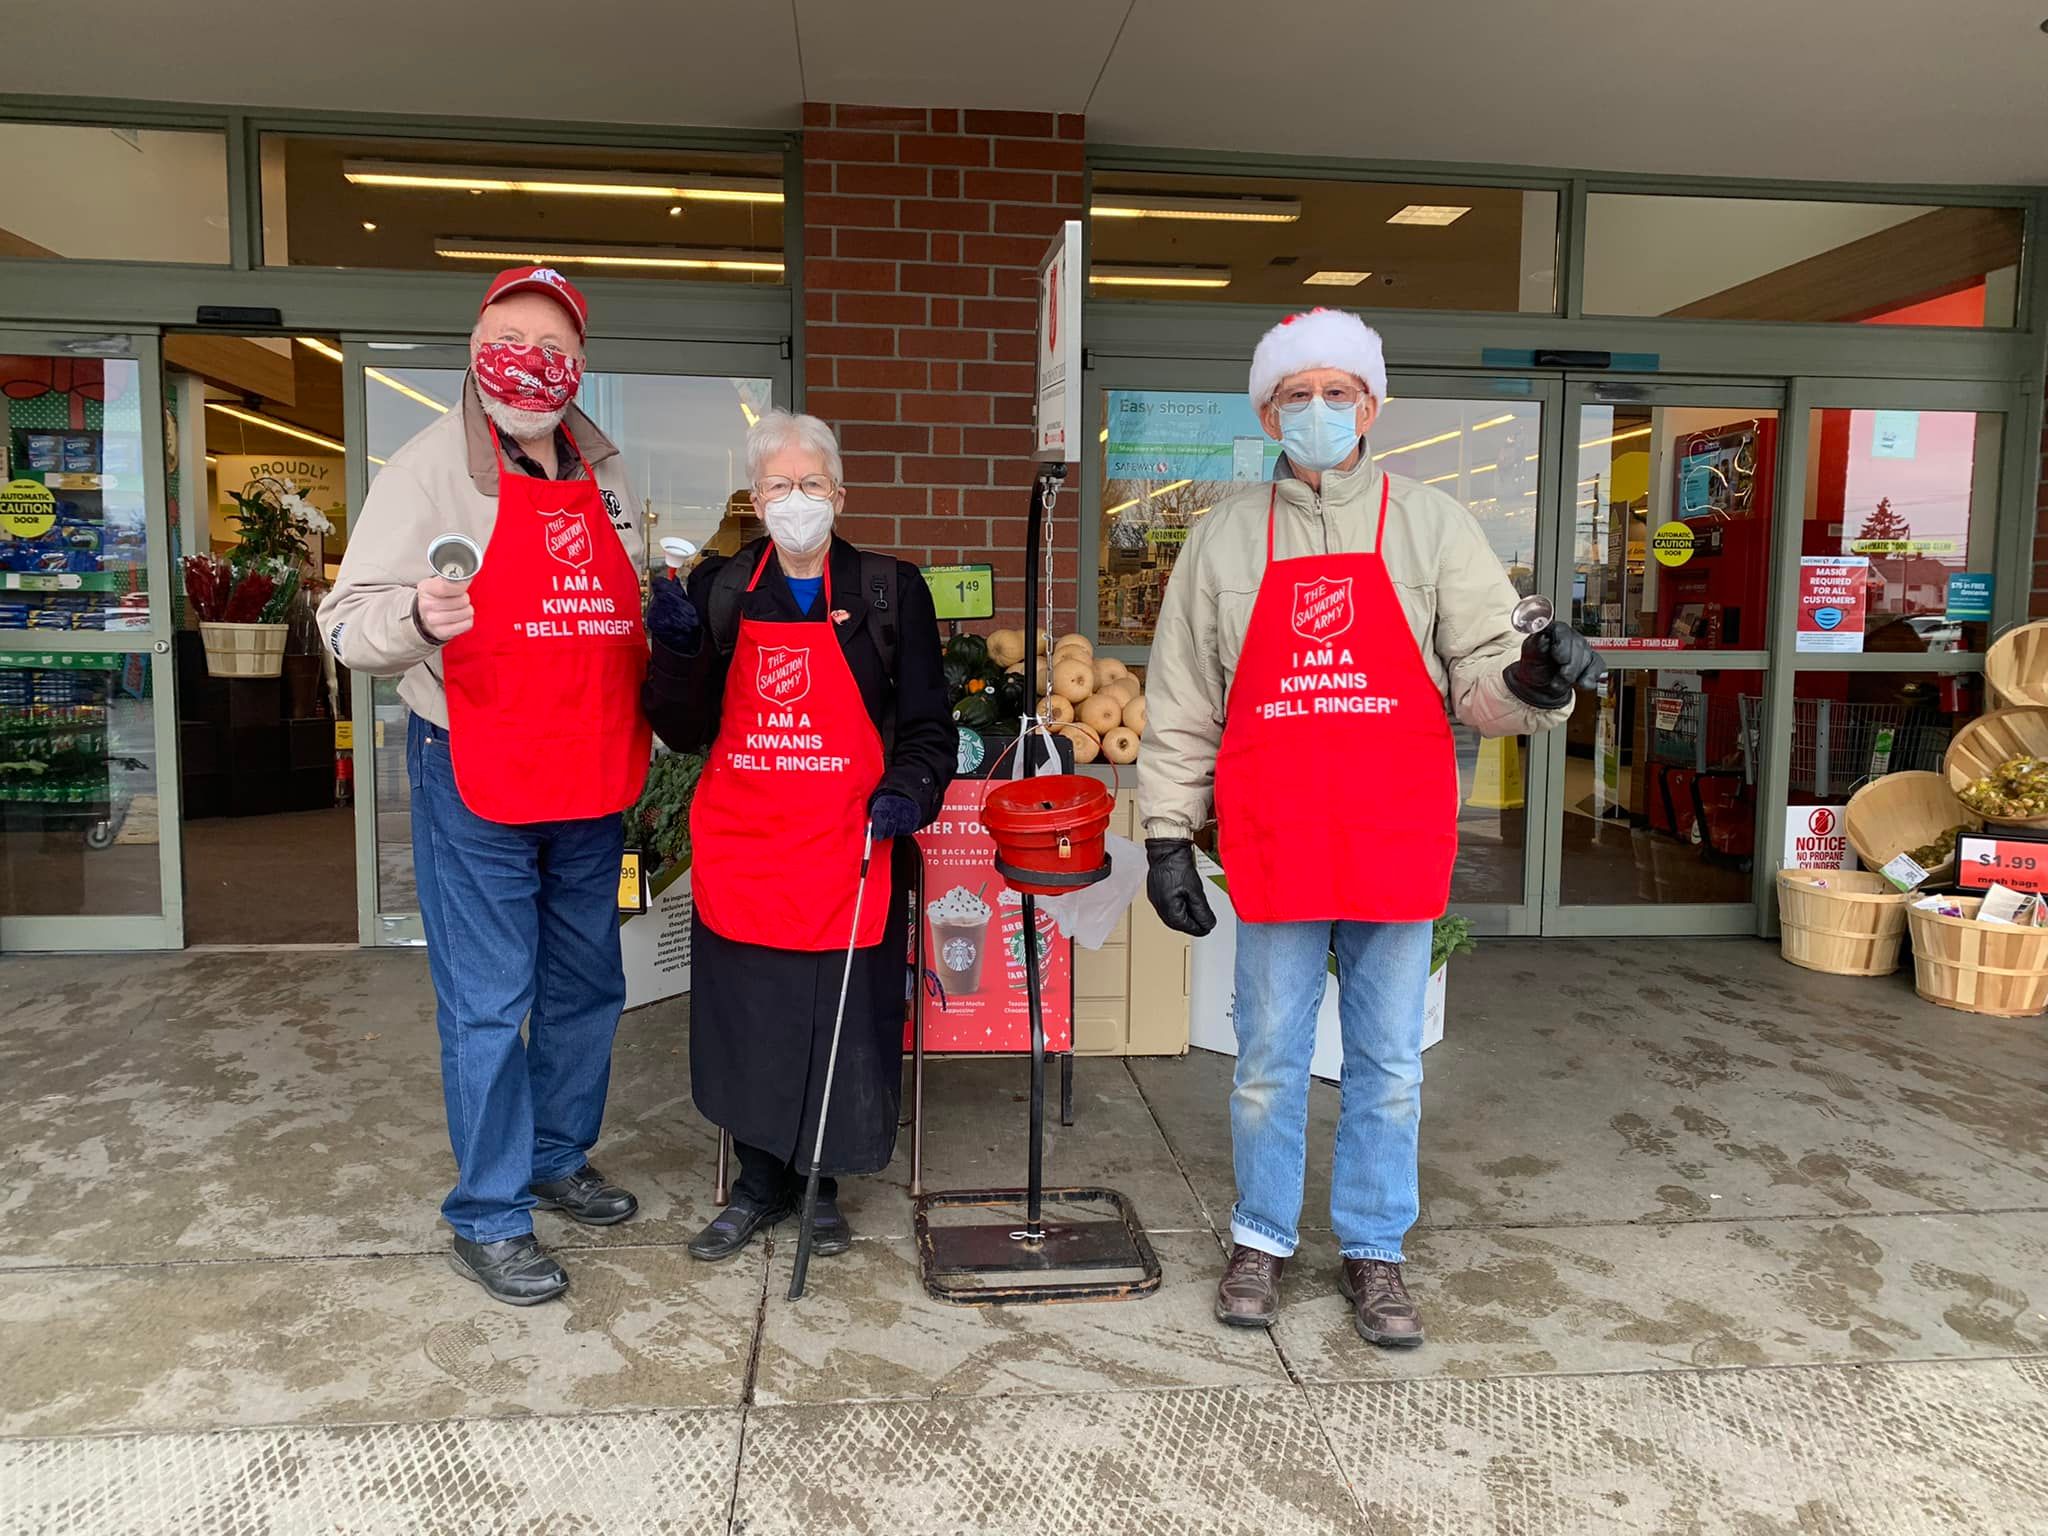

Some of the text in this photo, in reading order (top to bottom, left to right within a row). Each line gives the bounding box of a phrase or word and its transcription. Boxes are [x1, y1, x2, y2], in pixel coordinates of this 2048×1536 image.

[1119, 399, 1222, 416] Easy shops it.
[249, 461, 329, 480] PROUDLY
[1114, 462, 1155, 472] SAFEWAY
[0, 493, 50, 502] AUTOMATIC
[0, 503, 53, 514] CAUTION
[14, 516, 39, 524] DOOR
[548, 517, 566, 533] THE
[567, 535, 586, 559] ARMY
[1654, 540, 1692, 548] CAUTION
[1815, 567, 1847, 576] MASKS
[552, 575, 603, 591] I AM A
[1809, 577, 1852, 586] REQUIRED
[1303, 584, 1327, 605] THE
[1813, 586, 1847, 595] FOR ALL
[542, 598, 616, 615] KIWANIS
[1295, 585, 1346, 627] SALVATION
[1803, 596, 1857, 604] CUSTOMERS
[1312, 603, 1345, 633] ARMY
[577, 619, 634, 636] RINGER"
[1642, 639, 1660, 647] STAND
[1661, 639, 1679, 647] CLEAR
[767, 652, 786, 669] THE
[1292, 649, 1354, 669] I AM A
[759, 655, 804, 690] SALVATION
[774, 672, 802, 697] ARMY
[1280, 672, 1368, 693] KIWANIS
[1255, 696, 1399, 719] "BELL RINGER"
[757, 712, 811, 728] I AM A
[746, 734, 823, 750] KIWANIS
[727, 752, 851, 773] "BELL RINGER"
[1796, 836, 1847, 851] NOTICE
[941, 848, 966, 856] BACK
[969, 848, 989, 856] AND
[1796, 851, 1845, 861] NO PROPANE
[927, 858, 995, 866] TO CELEBRATE
[1799, 861, 1841, 870] CYLINDERS
[1979, 853, 2037, 870] $1.99
[1977, 876, 2039, 888] mesh bags
[663, 892, 691, 904] Be inspired
[661, 902, 684, 913] exclusive
[660, 927, 684, 939] designed
[657, 940, 673, 948] home
[658, 947, 677, 957] created
[654, 953, 685, 967] entertaining
